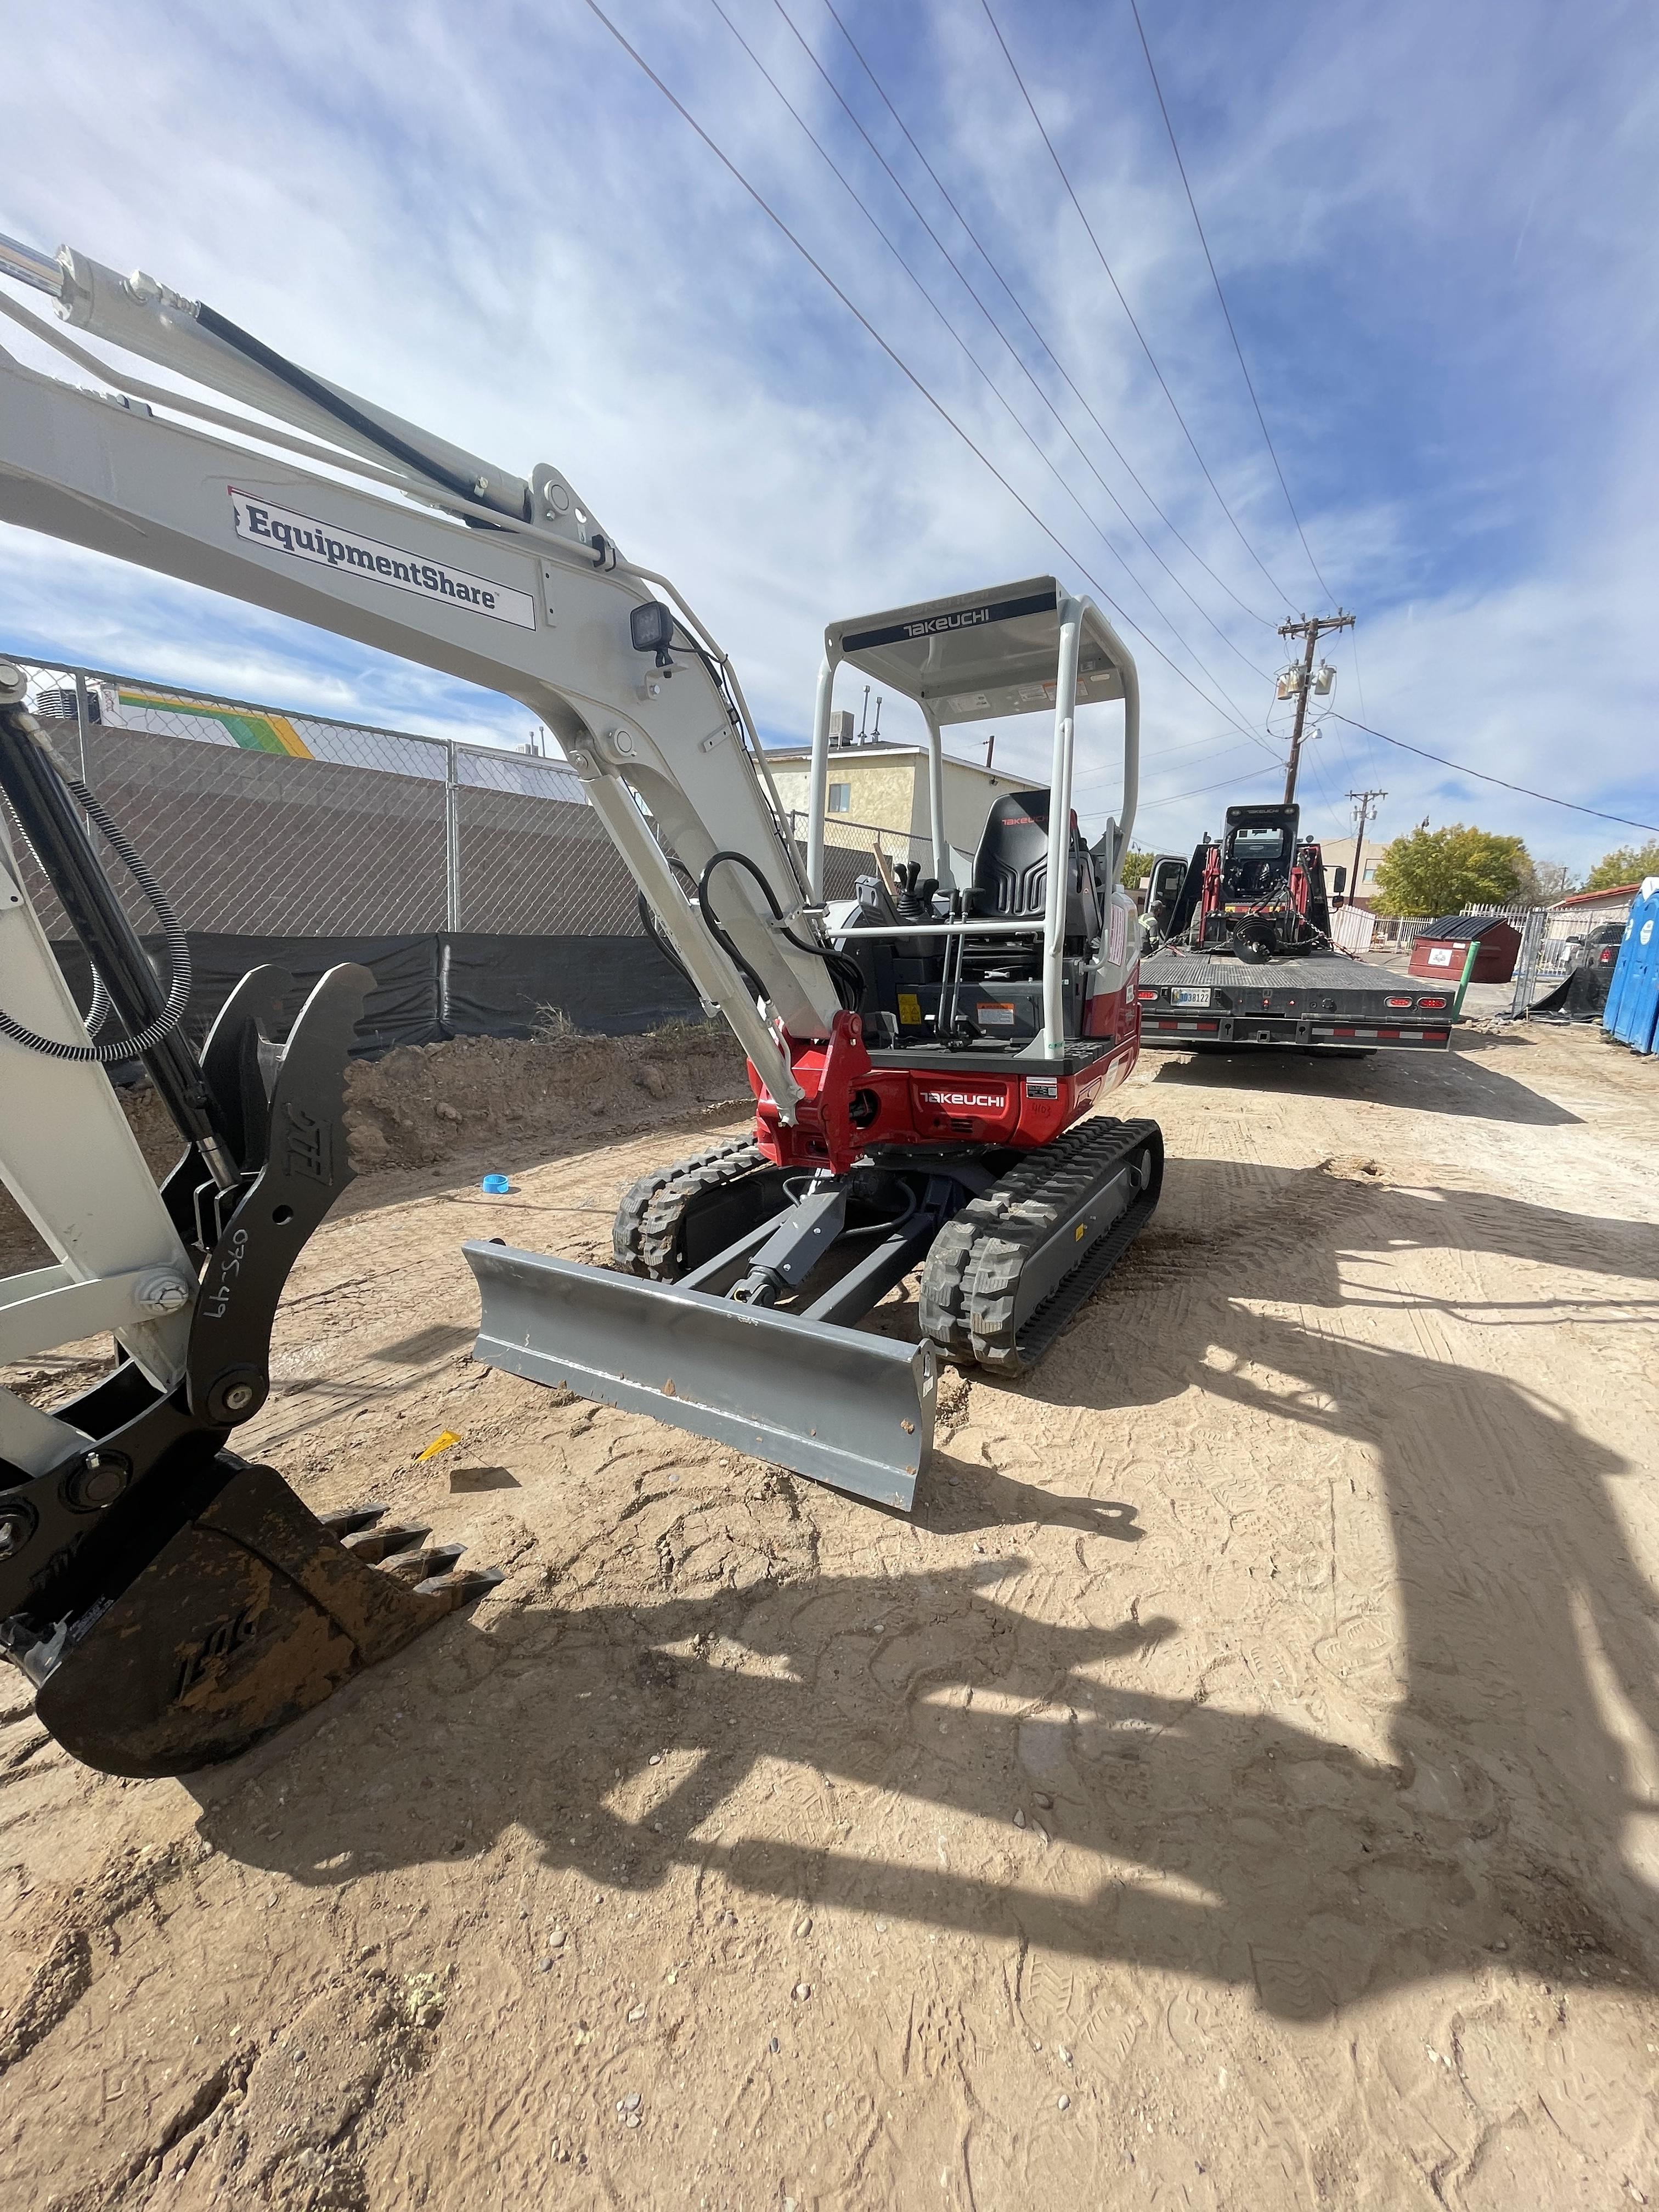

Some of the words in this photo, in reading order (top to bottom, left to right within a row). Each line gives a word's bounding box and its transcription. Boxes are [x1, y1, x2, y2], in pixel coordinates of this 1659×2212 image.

[245, 504, 495, 610] EquipmentShare
[903, 608, 990, 637] TAKEUCHI
[920, 1091, 1005, 1108] TAKEUCHI
